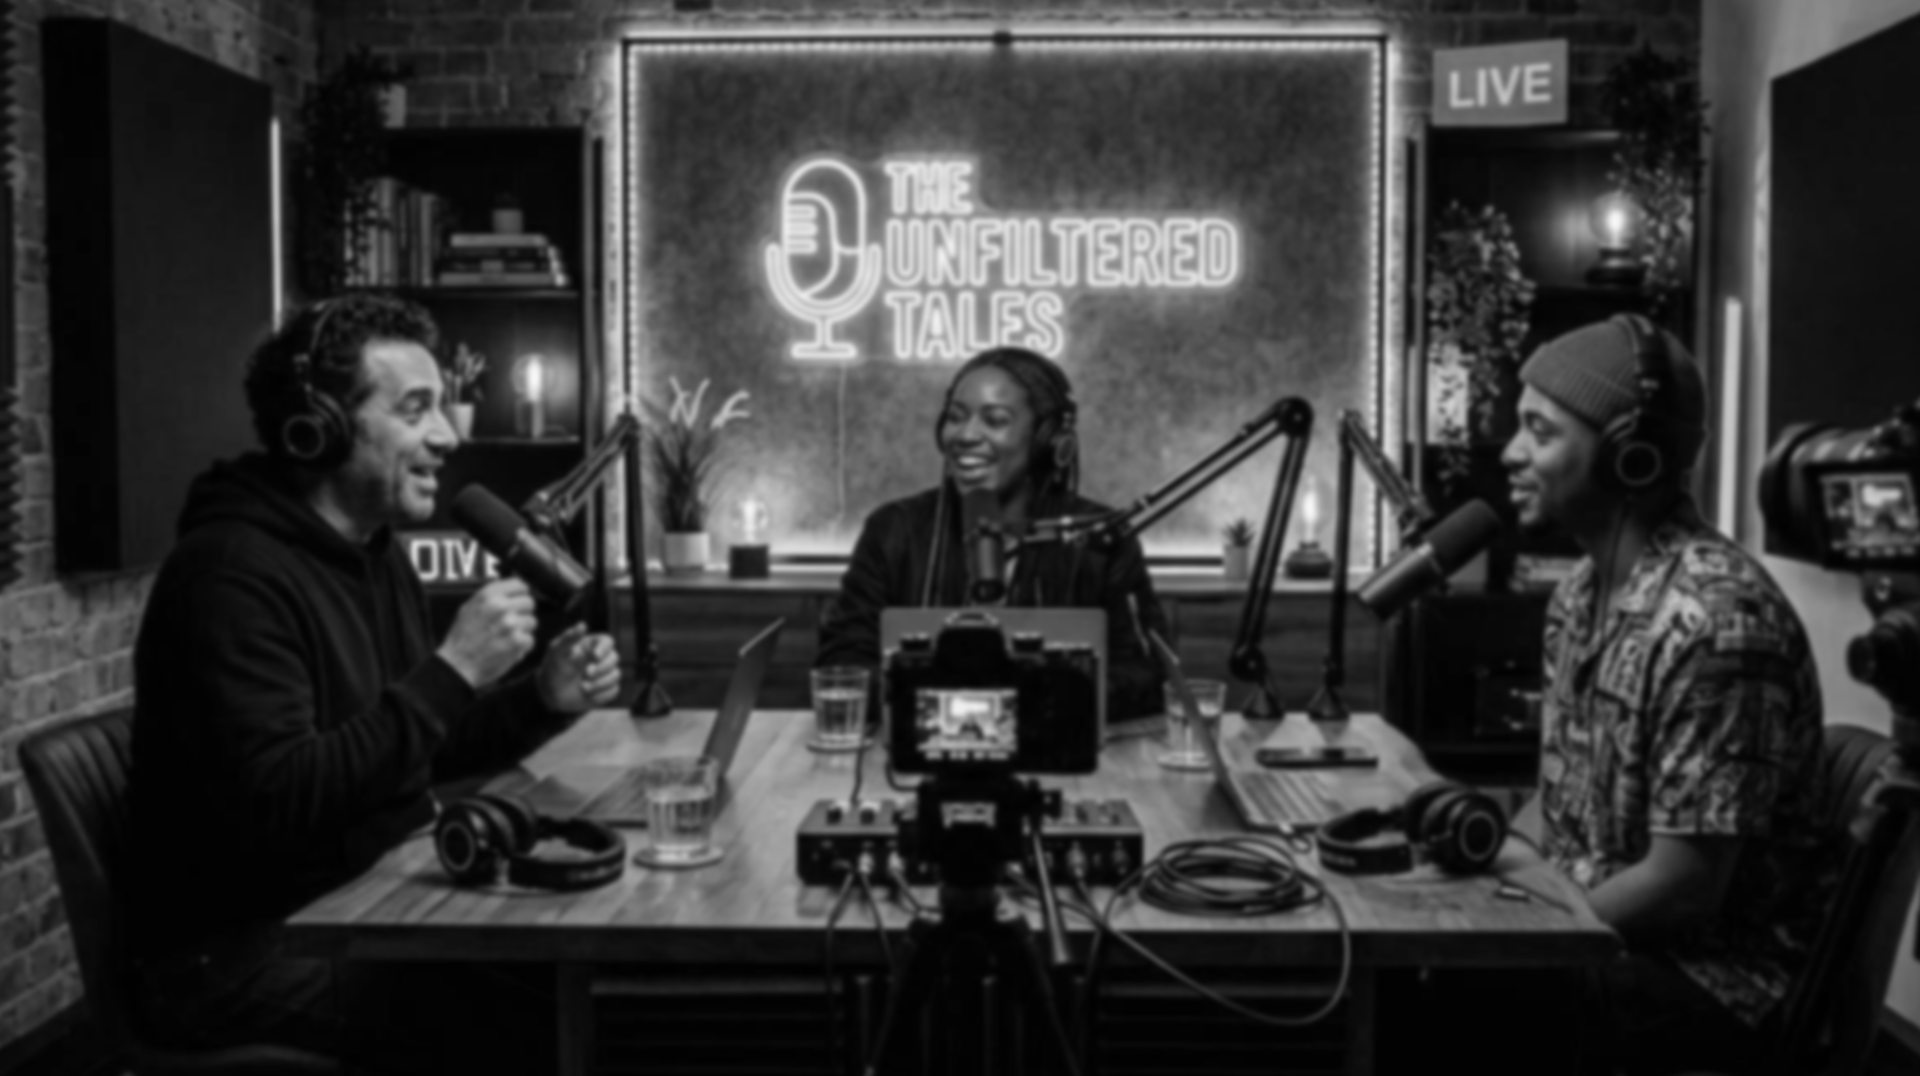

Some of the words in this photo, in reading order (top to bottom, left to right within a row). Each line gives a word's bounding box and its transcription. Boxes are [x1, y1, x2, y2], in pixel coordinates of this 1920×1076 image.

[1449, 61, 1552, 109] LIVE
[883, 160, 974, 215] THE
[884, 216, 1240, 288] UNFILTERED
[883, 289, 1067, 360] TALES
